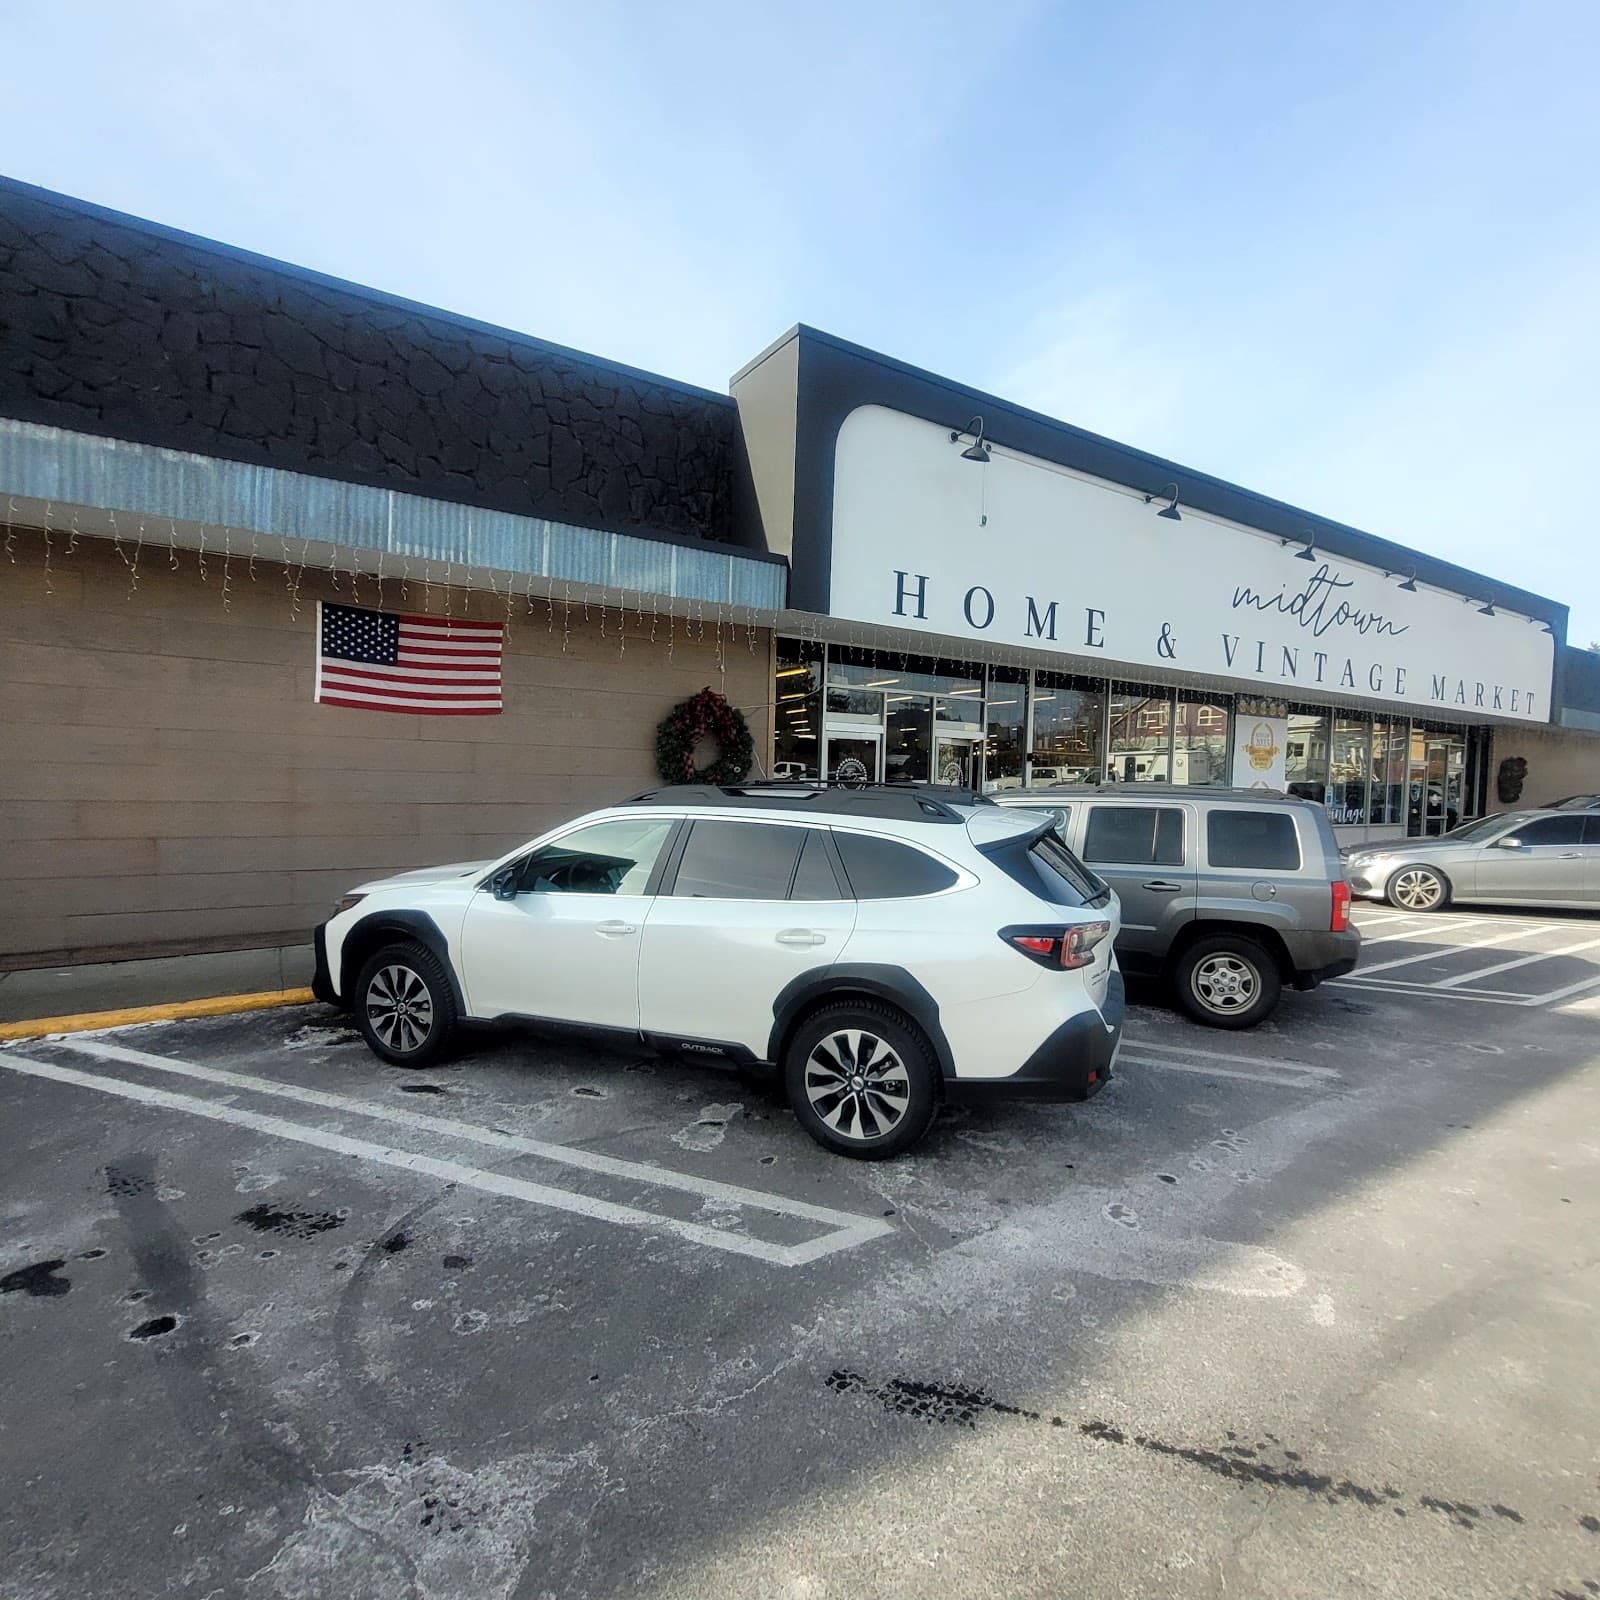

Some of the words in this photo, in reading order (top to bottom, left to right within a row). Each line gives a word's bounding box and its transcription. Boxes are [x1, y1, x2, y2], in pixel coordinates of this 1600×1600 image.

[1232, 564, 1409, 637] midtown
[891, 570, 1106, 648] HOME
[1157, 622, 1177, 659] &
[1222, 633, 1407, 695] VINTAGE
[1431, 673, 1536, 715] MARKET
[681, 1043, 724, 1054] OUTBACK
